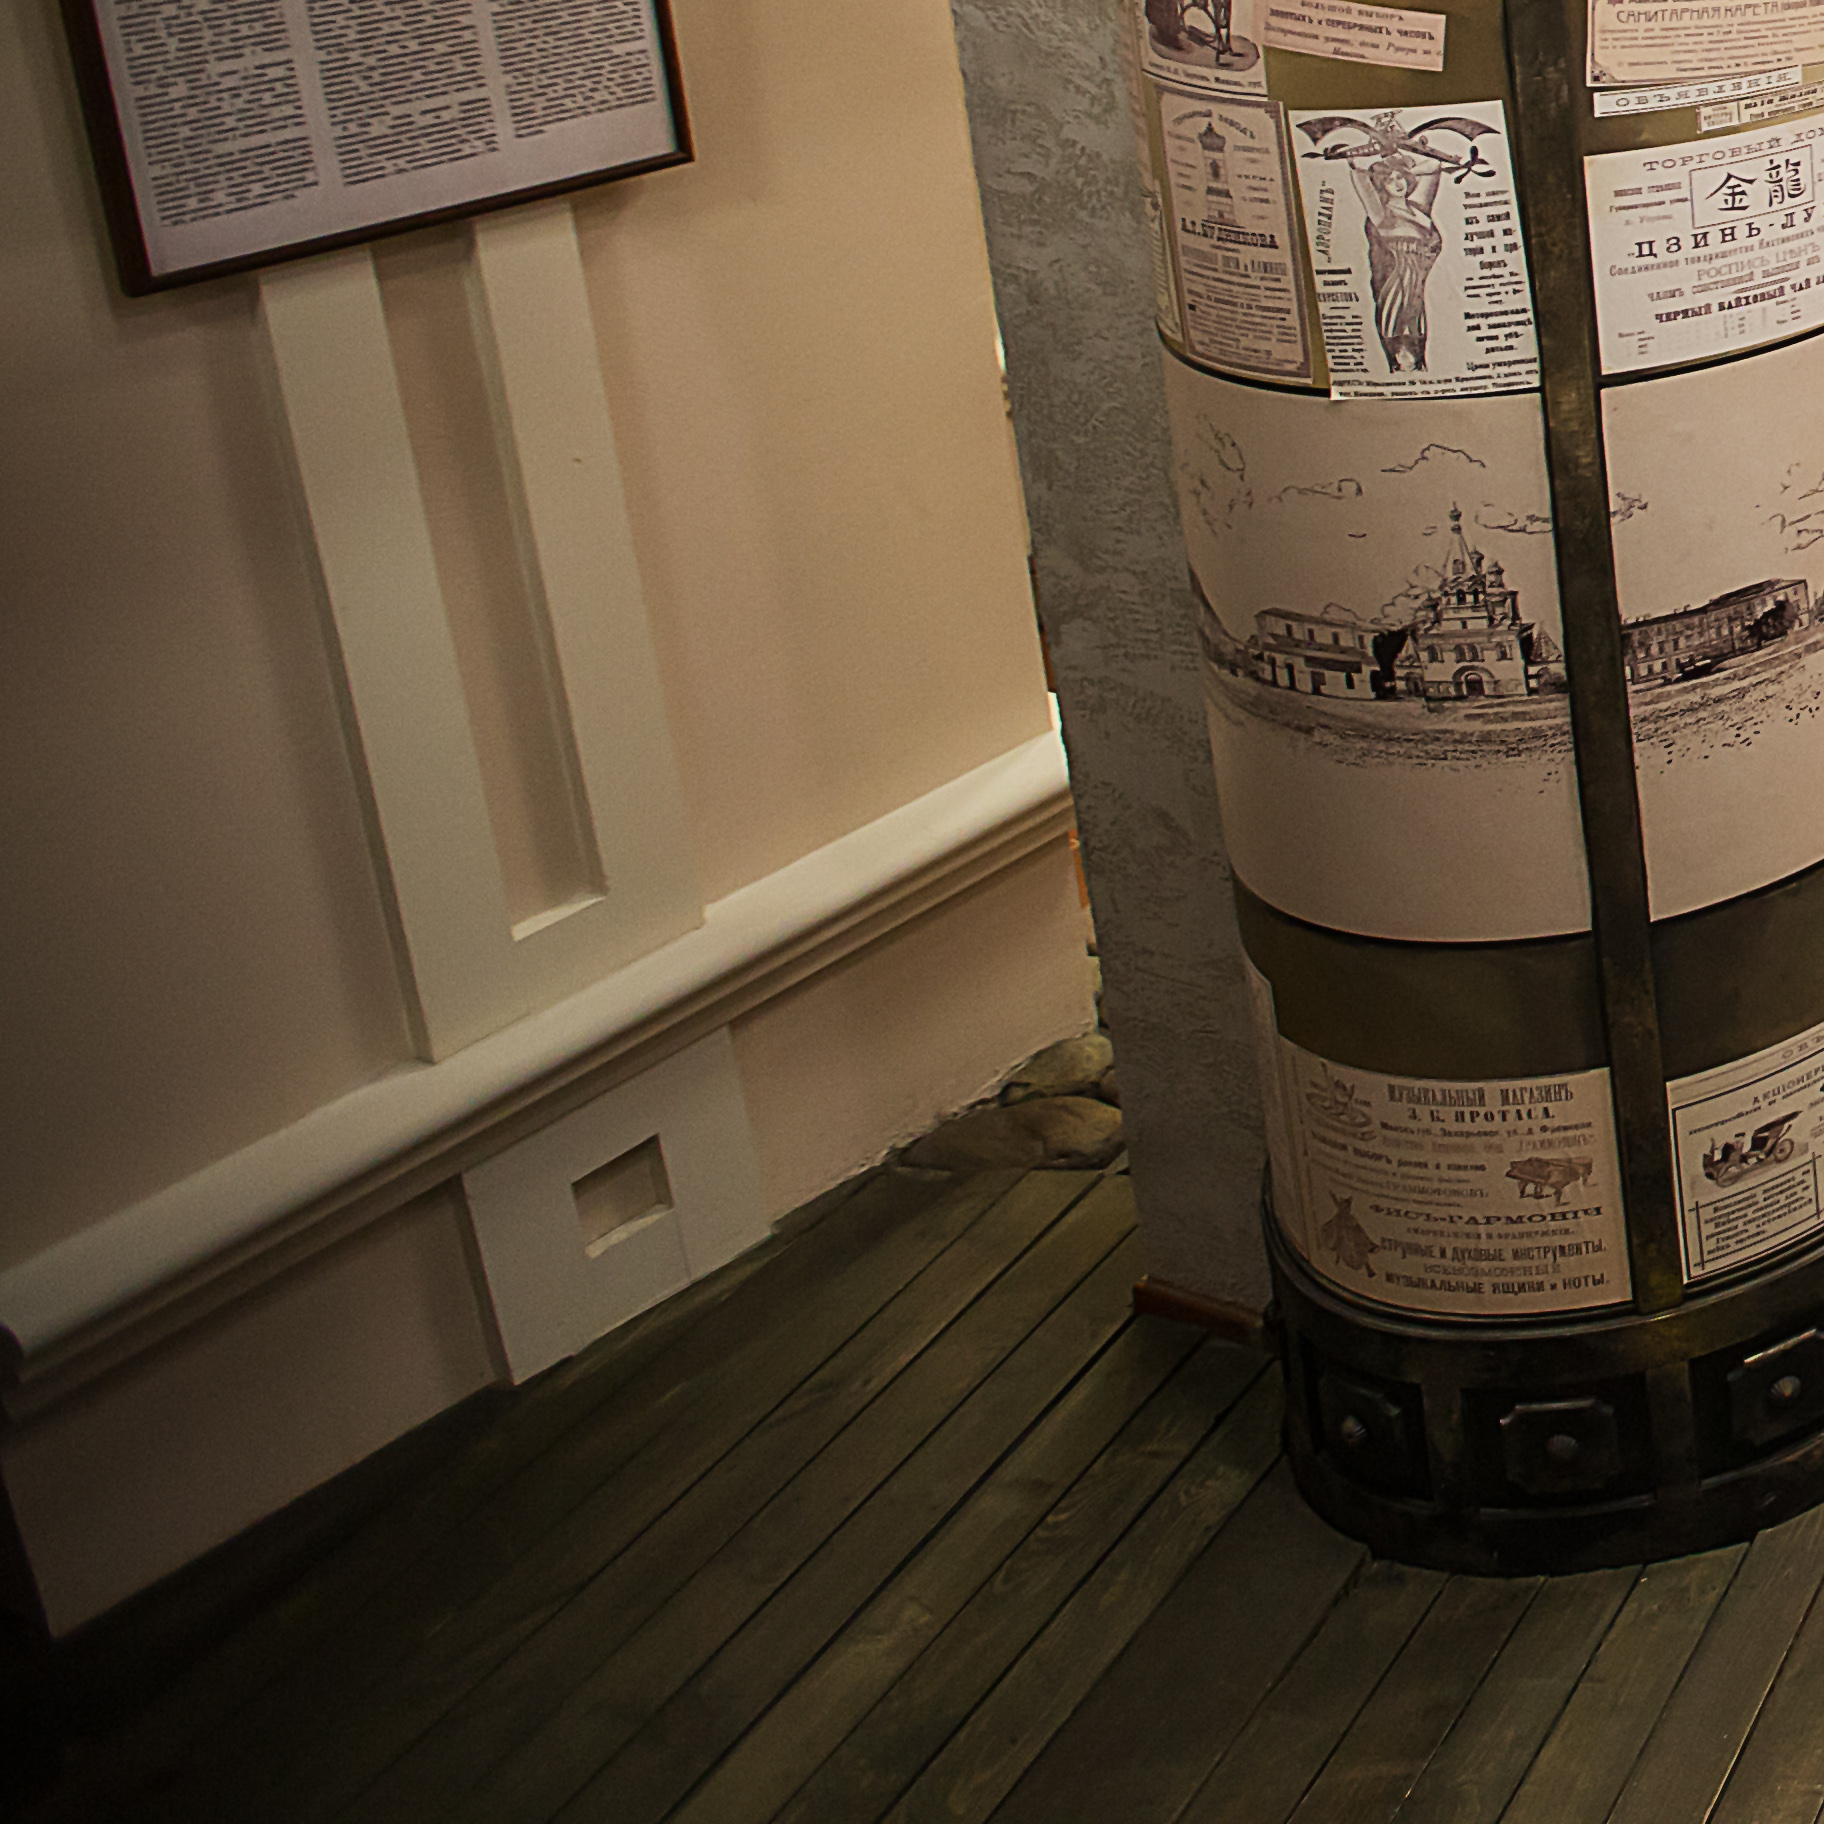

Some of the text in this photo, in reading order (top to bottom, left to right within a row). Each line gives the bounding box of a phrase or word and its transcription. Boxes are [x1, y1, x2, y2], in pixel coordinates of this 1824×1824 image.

[1616, 2, 1779, 24] САНИТАРНАЯ КАРЕТА
[1615, 72, 1792, 108] ОБЪЯВЛЕНІЯ
[1643, 137, 1782, 172] ТОРГОВЫЙ
[1705, 158, 1807, 211] 金龍
[1609, 258, 1679, 276] Соединенное
[1697, 242, 1821, 281] РОСПИСЬ ЦѢНЪ
[1655, 303, 1712, 323] ЧЕРНЫЙ
[1718, 286, 1785, 312] БАЙХОВЫЙ
[1790, 277, 1811, 293] ЧАЙ
[1387, 1082, 1573, 1107] МУЗЫКАЛЬНЫЙ МАГАЗИНЪ
[1451, 1246, 1505, 1264] ДУХОВЫЕ
[1385, 1271, 1485, 1294] МУЗЫКАЛЬНЫЕ
[1491, 1281, 1545, 1297] ЯЩИКИ
[1562, 1271, 1610, 1291] НОТЫ.
